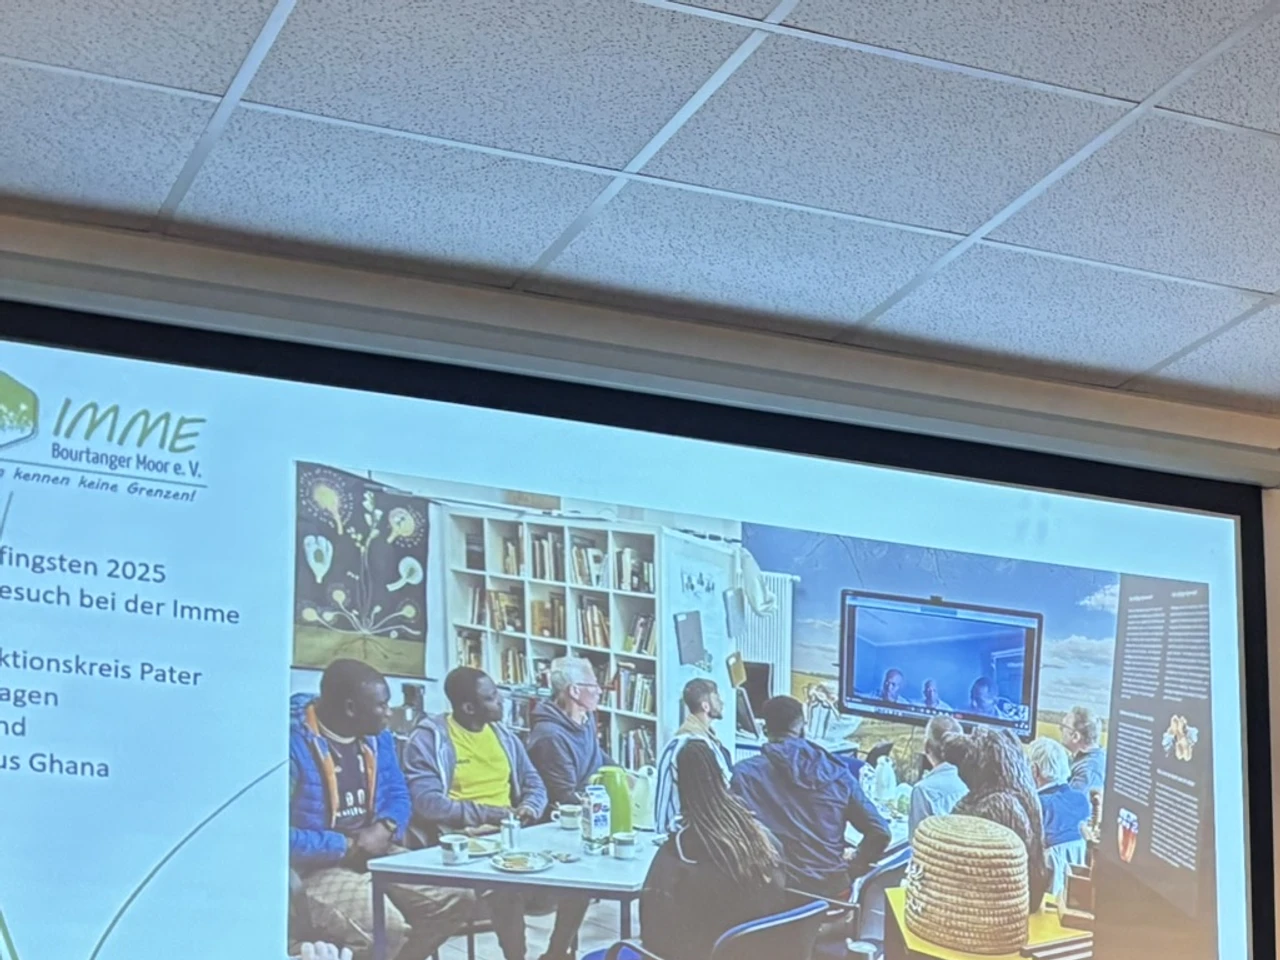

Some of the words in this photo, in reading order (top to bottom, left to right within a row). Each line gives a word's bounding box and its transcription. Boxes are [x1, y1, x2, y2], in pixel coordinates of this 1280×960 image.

[53, 397, 207, 453] IMME
[52, 442, 133, 470] Bourtanger
[136, 453, 170, 473] Moor
[173, 462, 186, 476] e.
[189, 460, 202, 478] V.
[13, 467, 71, 486] kennen
[78, 475, 119, 493] keine
[126, 482, 197, 502] Grenzen!
[107, 558, 166, 584] 2025
[79, 587, 116, 611] bei
[124, 593, 166, 617] der
[172, 599, 240, 624] Imme
[140, 662, 203, 686] Pater
[28, 752, 109, 778] Ghana
